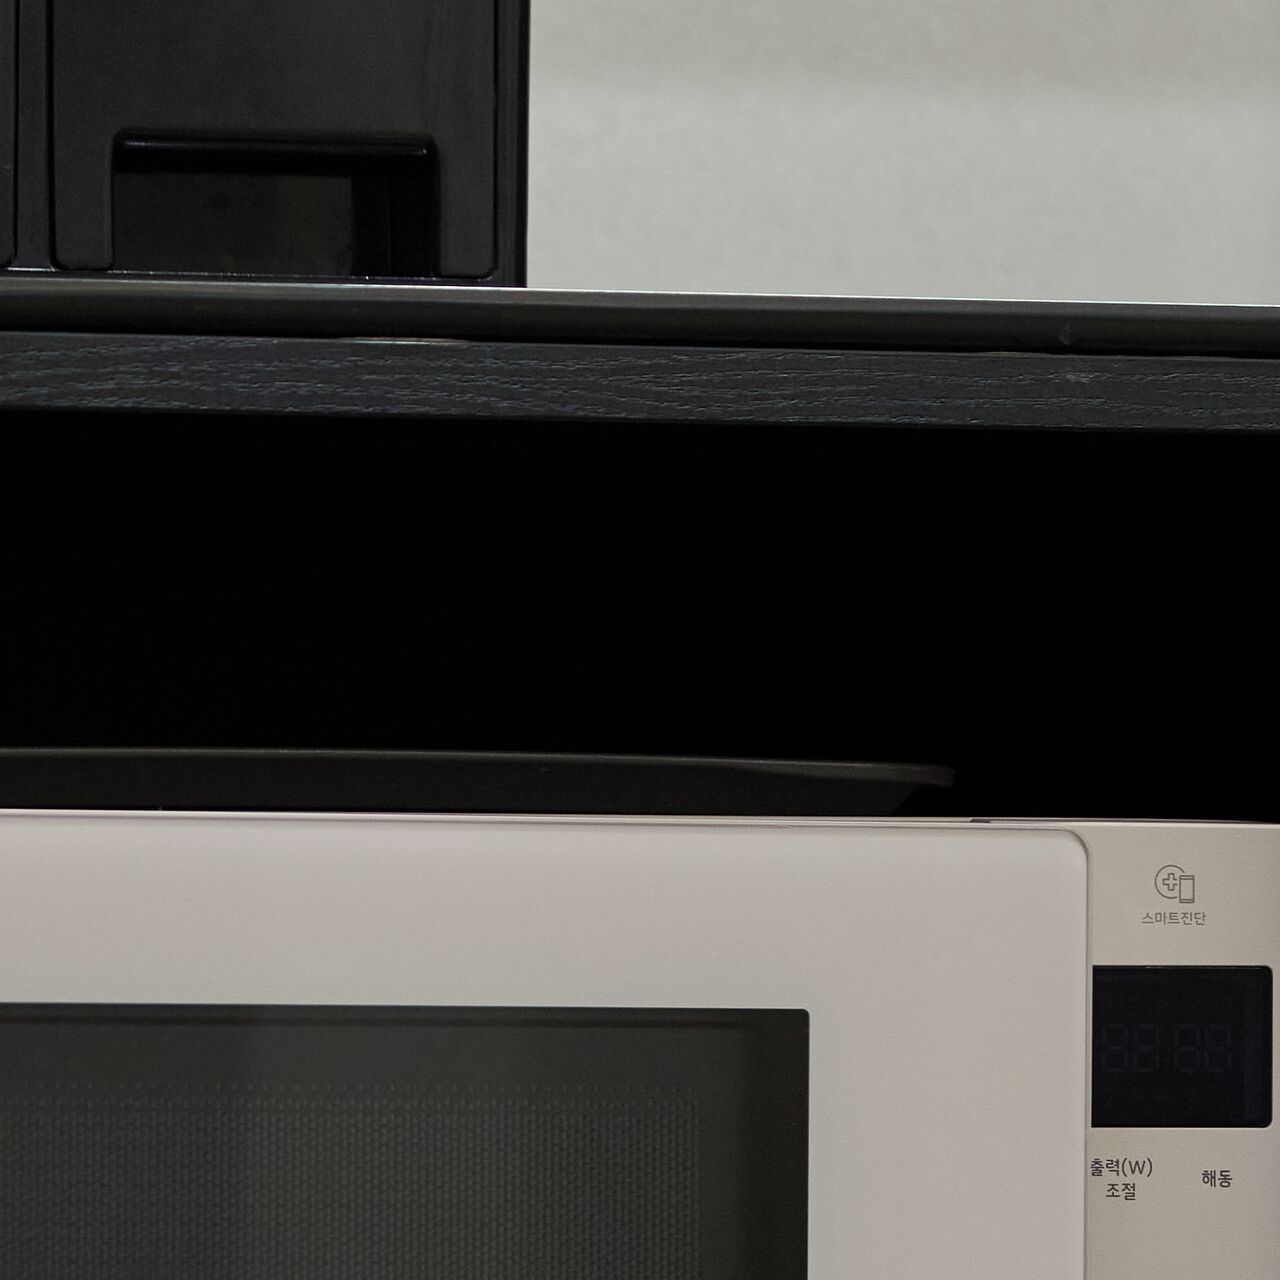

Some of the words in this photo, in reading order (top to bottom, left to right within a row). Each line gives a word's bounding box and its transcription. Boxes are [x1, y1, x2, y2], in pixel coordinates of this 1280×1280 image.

[1141, 911, 1206, 925] 스마트진단
[1090, 1157, 1153, 1177] 출력(W)
[1201, 1170, 1233, 1188] 해동
[1105, 1183, 1137, 1201] 조절
